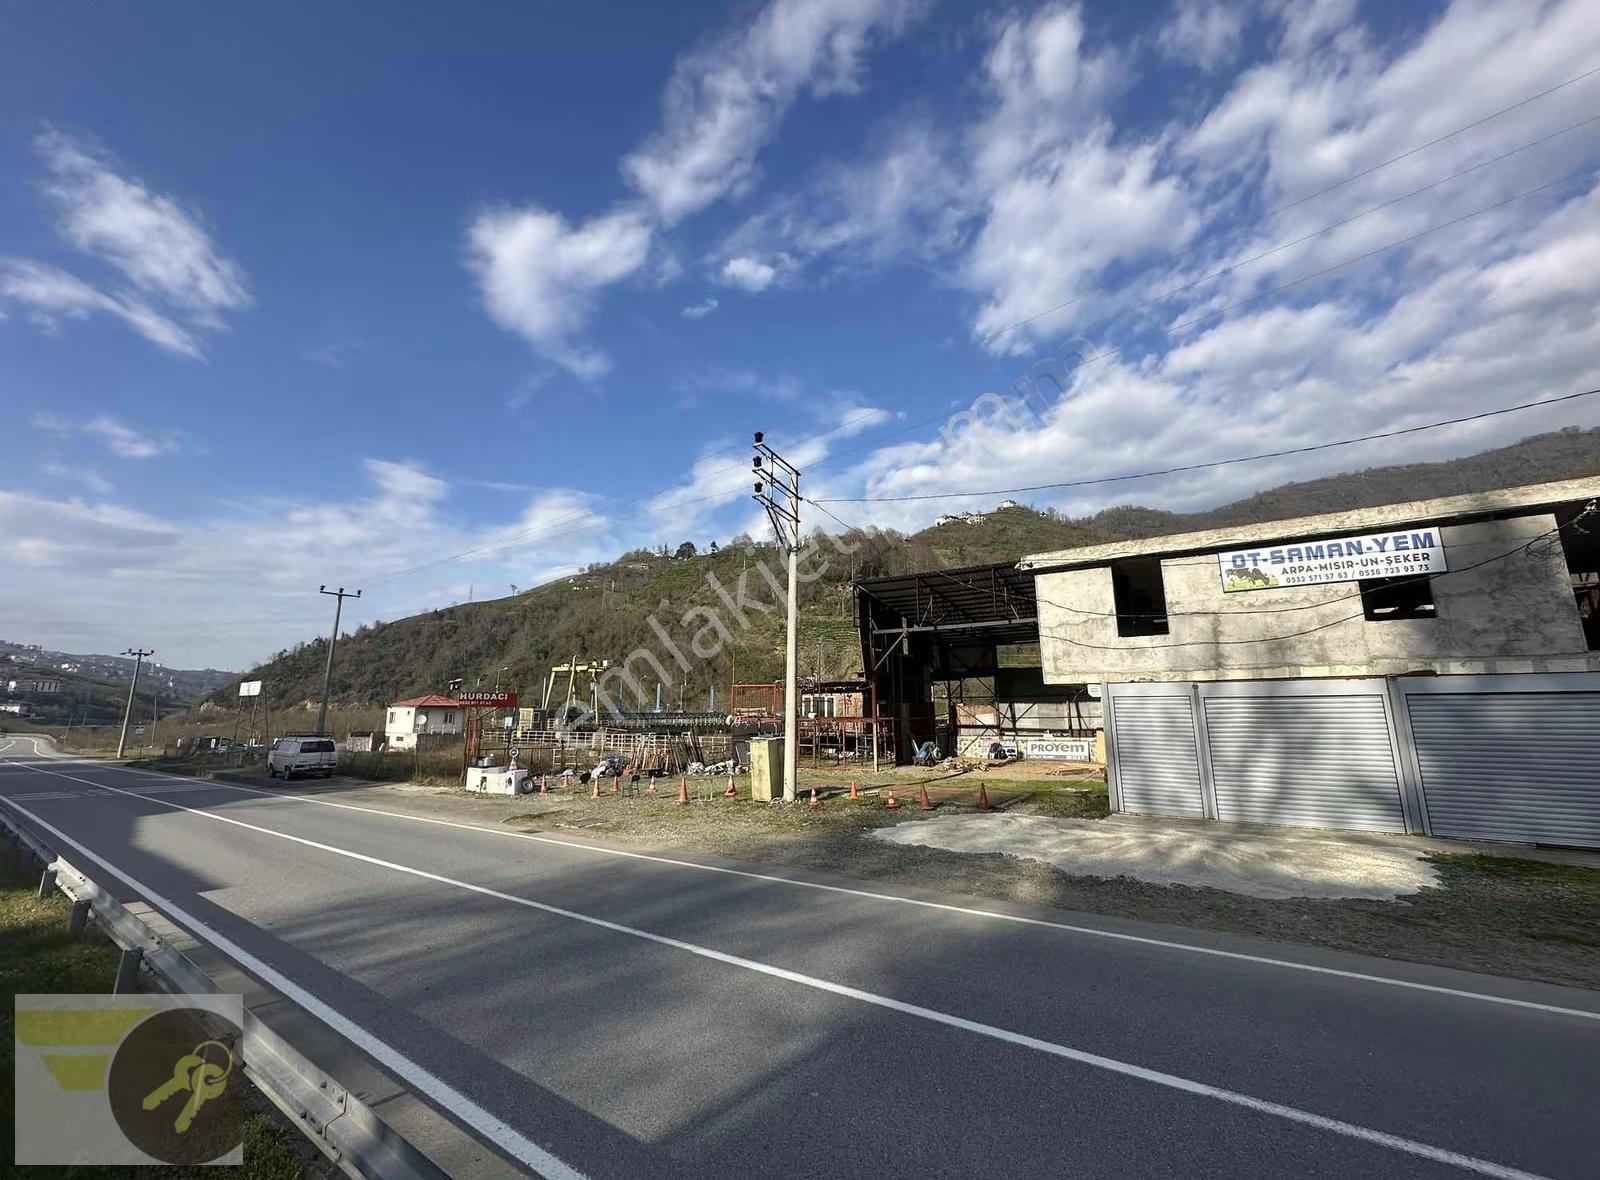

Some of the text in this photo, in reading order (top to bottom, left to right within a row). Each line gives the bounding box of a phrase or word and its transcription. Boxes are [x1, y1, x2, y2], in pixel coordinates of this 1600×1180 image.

[1232, 532, 1435, 568] OT-SAMAN-YEM
[1281, 553, 1430, 575] ARPA-MISIR-UN-ŞEKER
[1359, 568, 1381, 577] 0536
[1384, 566, 1401, 574] 723
[1418, 563, 1430, 571] 73
